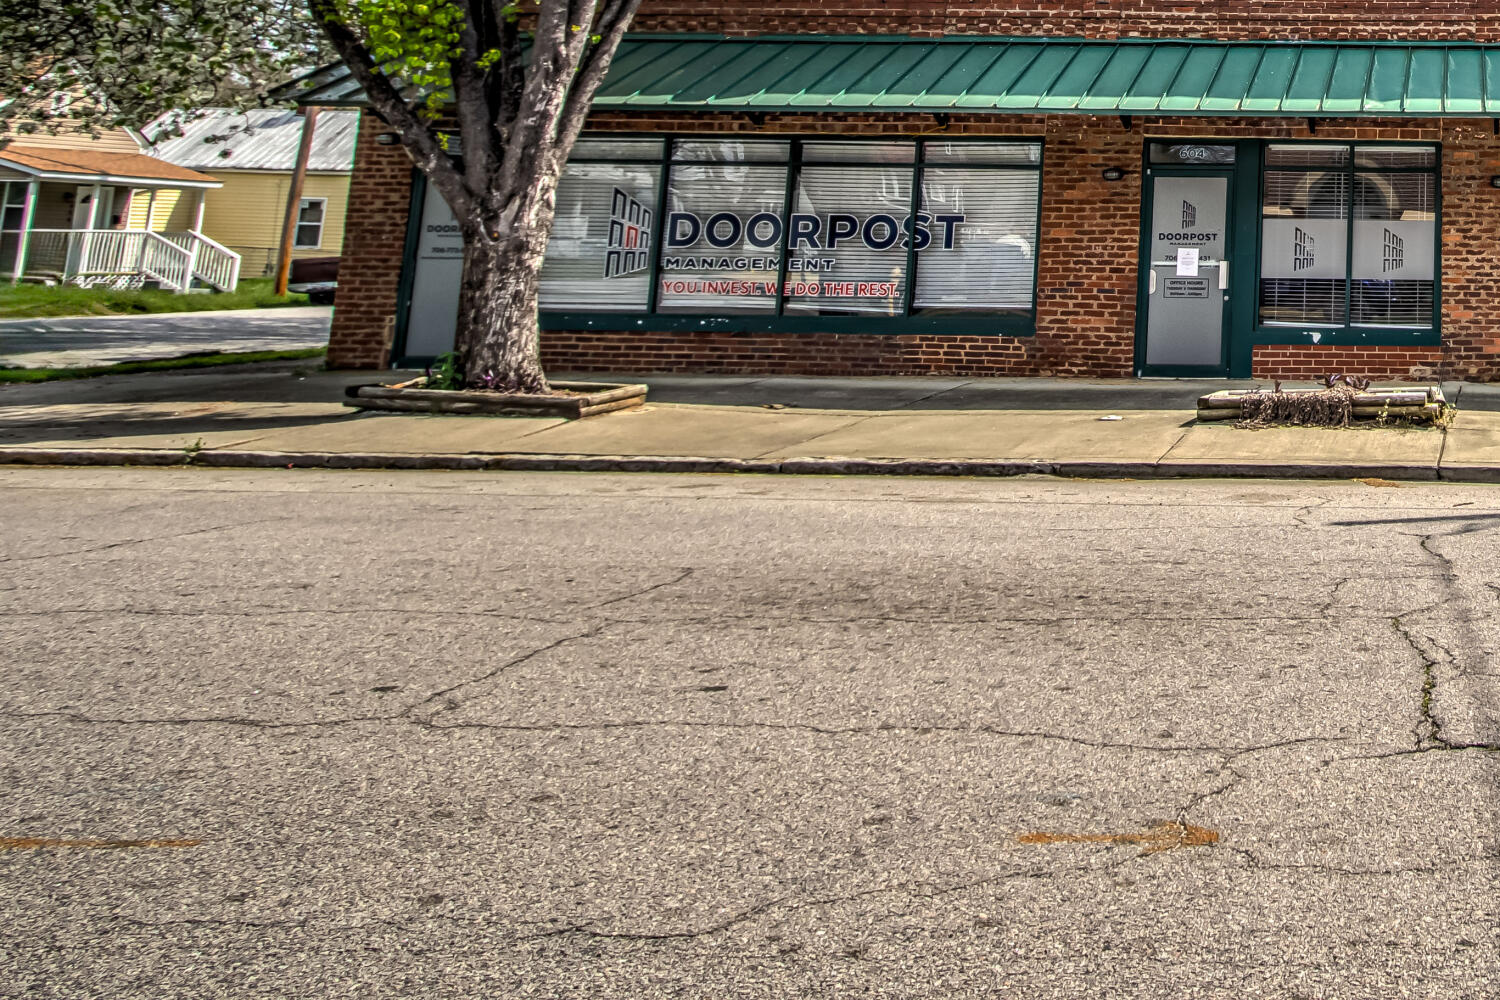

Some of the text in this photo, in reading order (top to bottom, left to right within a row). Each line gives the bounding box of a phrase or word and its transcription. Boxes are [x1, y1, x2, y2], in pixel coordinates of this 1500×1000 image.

[1179, 147, 1205, 159] 604
[427, 224, 462, 233] DOOR
[667, 211, 966, 251] DOORPOST
[1158, 232, 1217, 241] DOORPOST
[664, 256, 835, 272] MANAGEMENT
[663, 281, 900, 297] YOU INVEST. WE DO THE REST.
